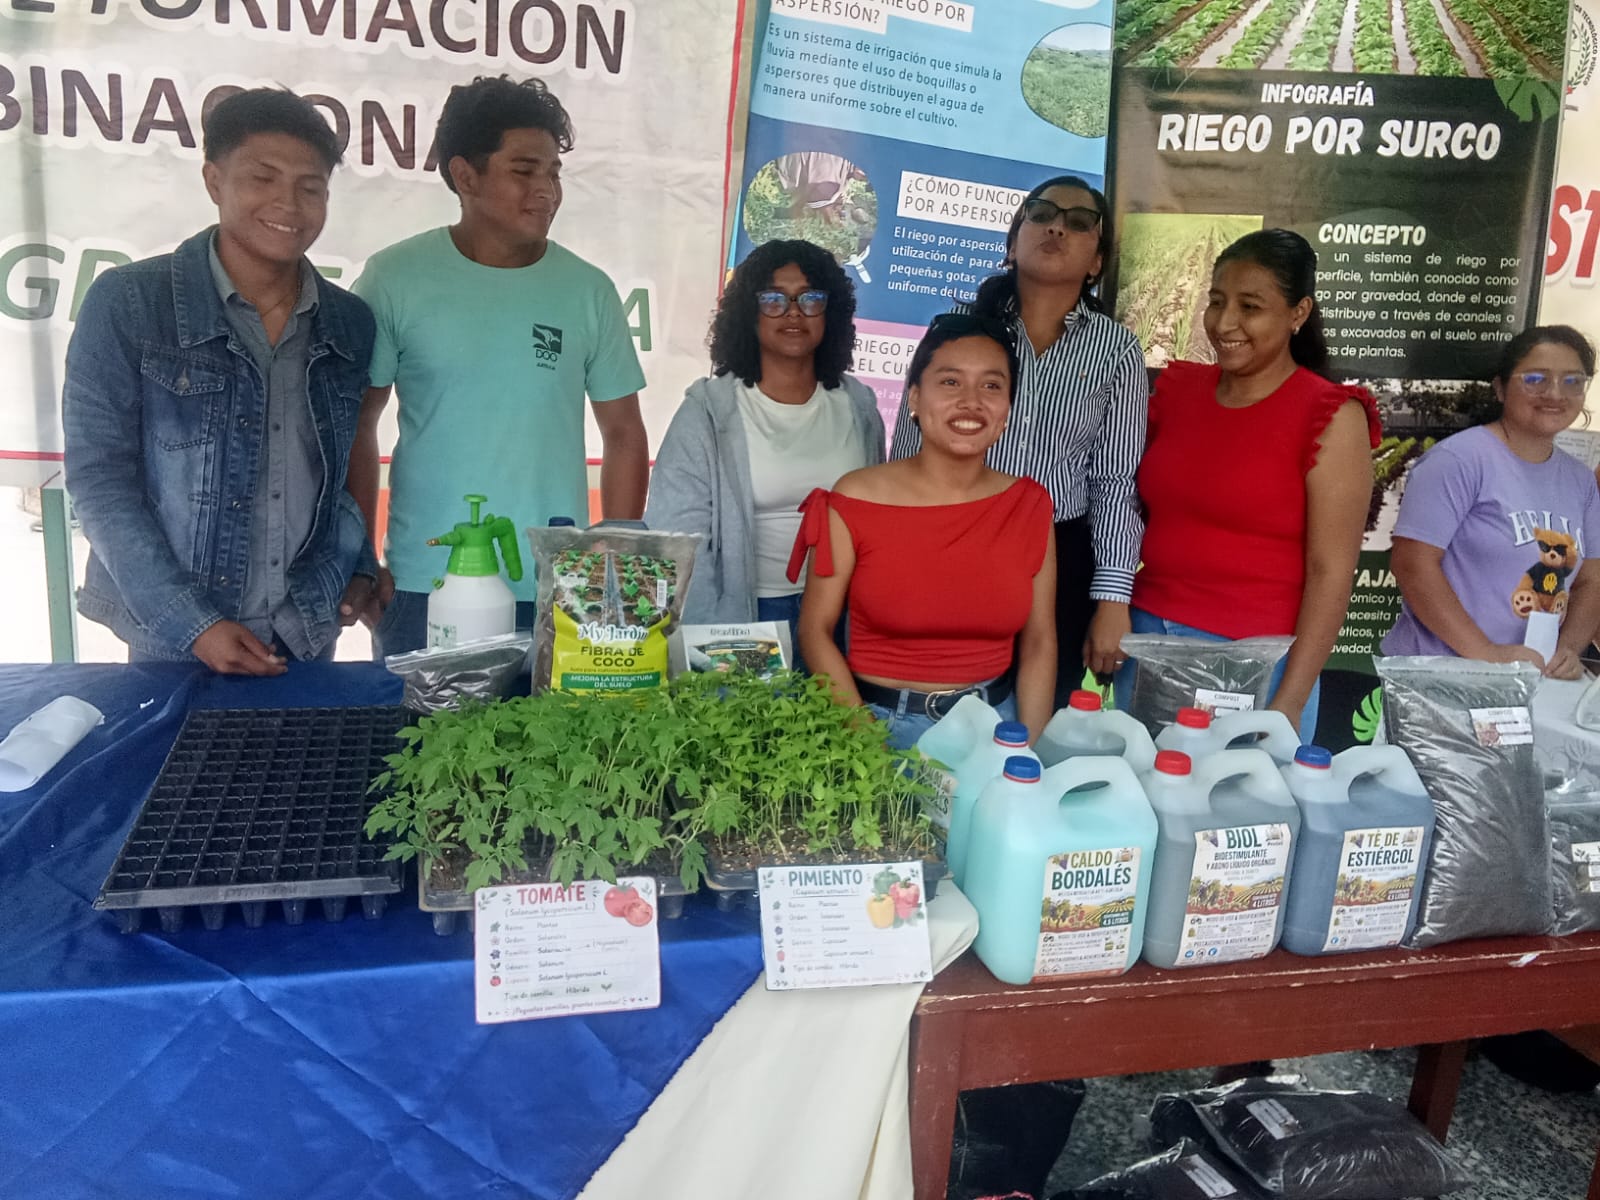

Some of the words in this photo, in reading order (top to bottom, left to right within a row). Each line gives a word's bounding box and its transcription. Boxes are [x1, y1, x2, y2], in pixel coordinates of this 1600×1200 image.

[935, 3, 966, 22] POR
[768, 22, 780, 37] Es
[784, 29, 799, 40] un
[804, 31, 851, 49] sistema
[856, 40, 870, 53] de
[874, 43, 926, 65] irrigación
[929, 58, 951, 70] que
[955, 62, 989, 79] simula
[993, 68, 1002, 81] la
[767, 41, 795, 60] lluvia
[800, 51, 859, 70] mediante
[862, 61, 873, 73] el
[875, 66, 895, 78] uso
[899, 68, 913, 81] de
[916, 71, 966, 92] boquillas
[969, 85, 977, 94] o
[765, 63, 829, 84] aspersores
[833, 76, 856, 89] que
[860, 79, 924, 102] distribuyen
[927, 93, 937, 104] el
[940, 97, 967, 111] agua
[970, 101, 984, 114] de
[1261, 81, 1374, 107] INFOGRAFÍA
[763, 83, 806, 100] manera
[810, 92, 867, 110] uniforme
[870, 102, 902, 117] sobre
[905, 108, 915, 119] el
[918, 112, 958, 127] cultivo.
[1157, 113, 1272, 153] RIEGO
[1286, 116, 1364, 155] POR
[1377, 119, 1501, 160] SURCO
[906, 177, 960, 197] ¿CÓMO
[965, 185, 1027, 207] FUNCIO
[904, 196, 935, 213] POR
[894, 226, 905, 238] El
[907, 229, 936, 245] riego
[938, 235, 958, 246] por
[1319, 223, 1426, 246] CONCEPTO
[892, 246, 947, 262] utilización
[950, 253, 964, 264] de
[969, 257, 993, 268] para
[1335, 253, 1349, 262] un
[1364, 252, 1411, 264] sistema
[1426, 252, 1441, 264] de
[1456, 254, 1487, 268] riego
[1501, 258, 1520, 269] por
[890, 264, 943, 279] pequeñas
[946, 272, 976, 283] gotas
[1315, 270, 1363, 283] perficie,
[1370, 270, 1419, 283] también
[1424, 273, 1480, 284] conocido
[1485, 276, 1519, 286] como
[888, 280, 937, 296] uniforme
[940, 286, 957, 297] del
[1336, 291, 1357, 302] por
[1361, 290, 1422, 303] gravedad,
[1427, 291, 1466, 303] donde
[1471, 292, 1481, 304] el
[1485, 295, 1517, 307] agua
[1380, 311, 1388, 319] a
[1394, 308, 1431, 320] través
[1435, 309, 1451, 321] de
[1456, 311, 1501, 323] canales
[1506, 314, 1515, 323] o
[1341, 327, 1406, 339] excavados
[1411, 329, 1426, 339] en
[1430, 328, 1441, 339] el
[1445, 329, 1477, 340] suelo
[1481, 330, 1513, 341] entre
[1341, 345, 1356, 356] de
[1359, 345, 1407, 359] plantas.
[1350, 593, 1385, 604] ómico
[581, 646, 624, 656] FIBRA
[628, 648, 645, 656] DE
[593, 657, 635, 667] COCO
[1226, 828, 1261, 849] BIOL
[1368, 829, 1382, 847] TÉ
[1384, 832, 1400, 847] DE
[1070, 850, 1113, 868] CALDO
[1347, 846, 1414, 867] ESTIÉRCOL
[788, 869, 863, 887] PIMIENTO
[1051, 863, 1132, 890] BORDALÉS
[517, 885, 585, 905] TOMATE
